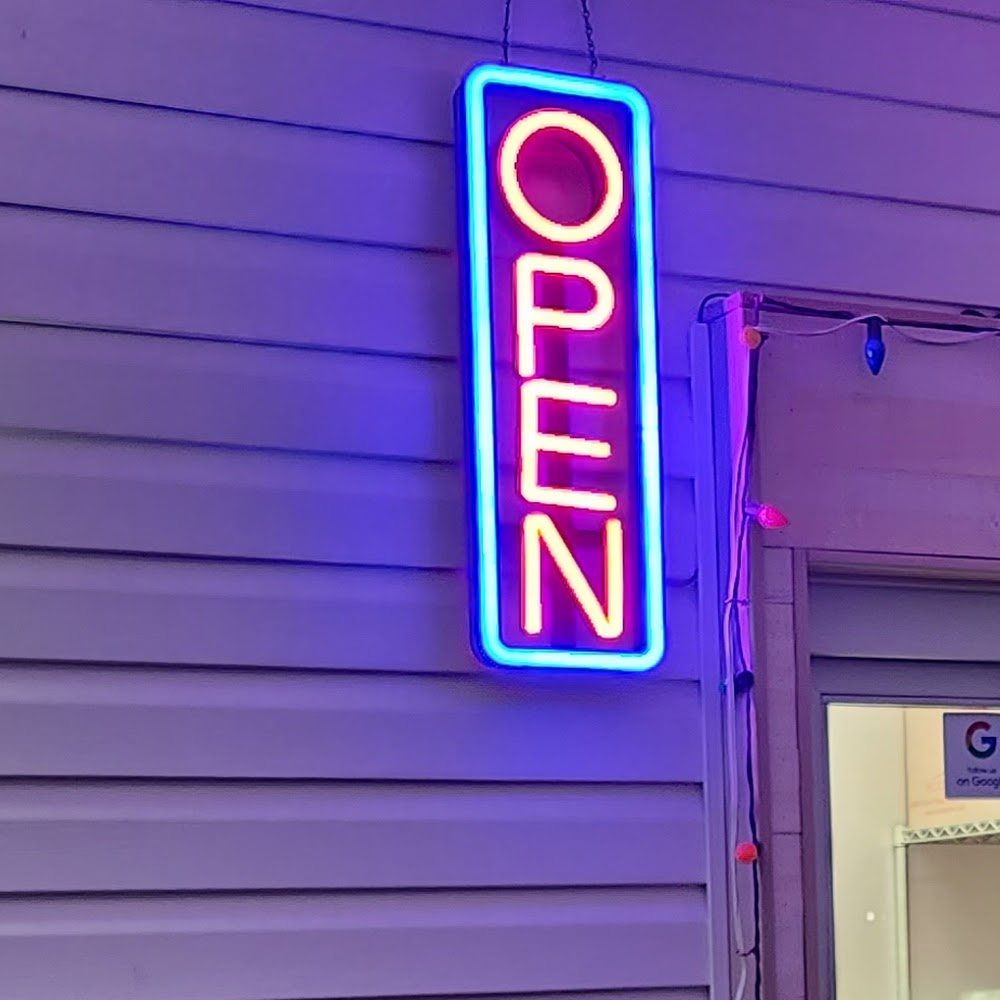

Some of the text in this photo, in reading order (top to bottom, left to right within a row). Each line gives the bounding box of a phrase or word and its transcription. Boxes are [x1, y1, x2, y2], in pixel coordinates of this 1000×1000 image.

[499, 108, 624, 639] OPEN
[965, 721, 997, 759] G
[956, 778, 970, 786] on
